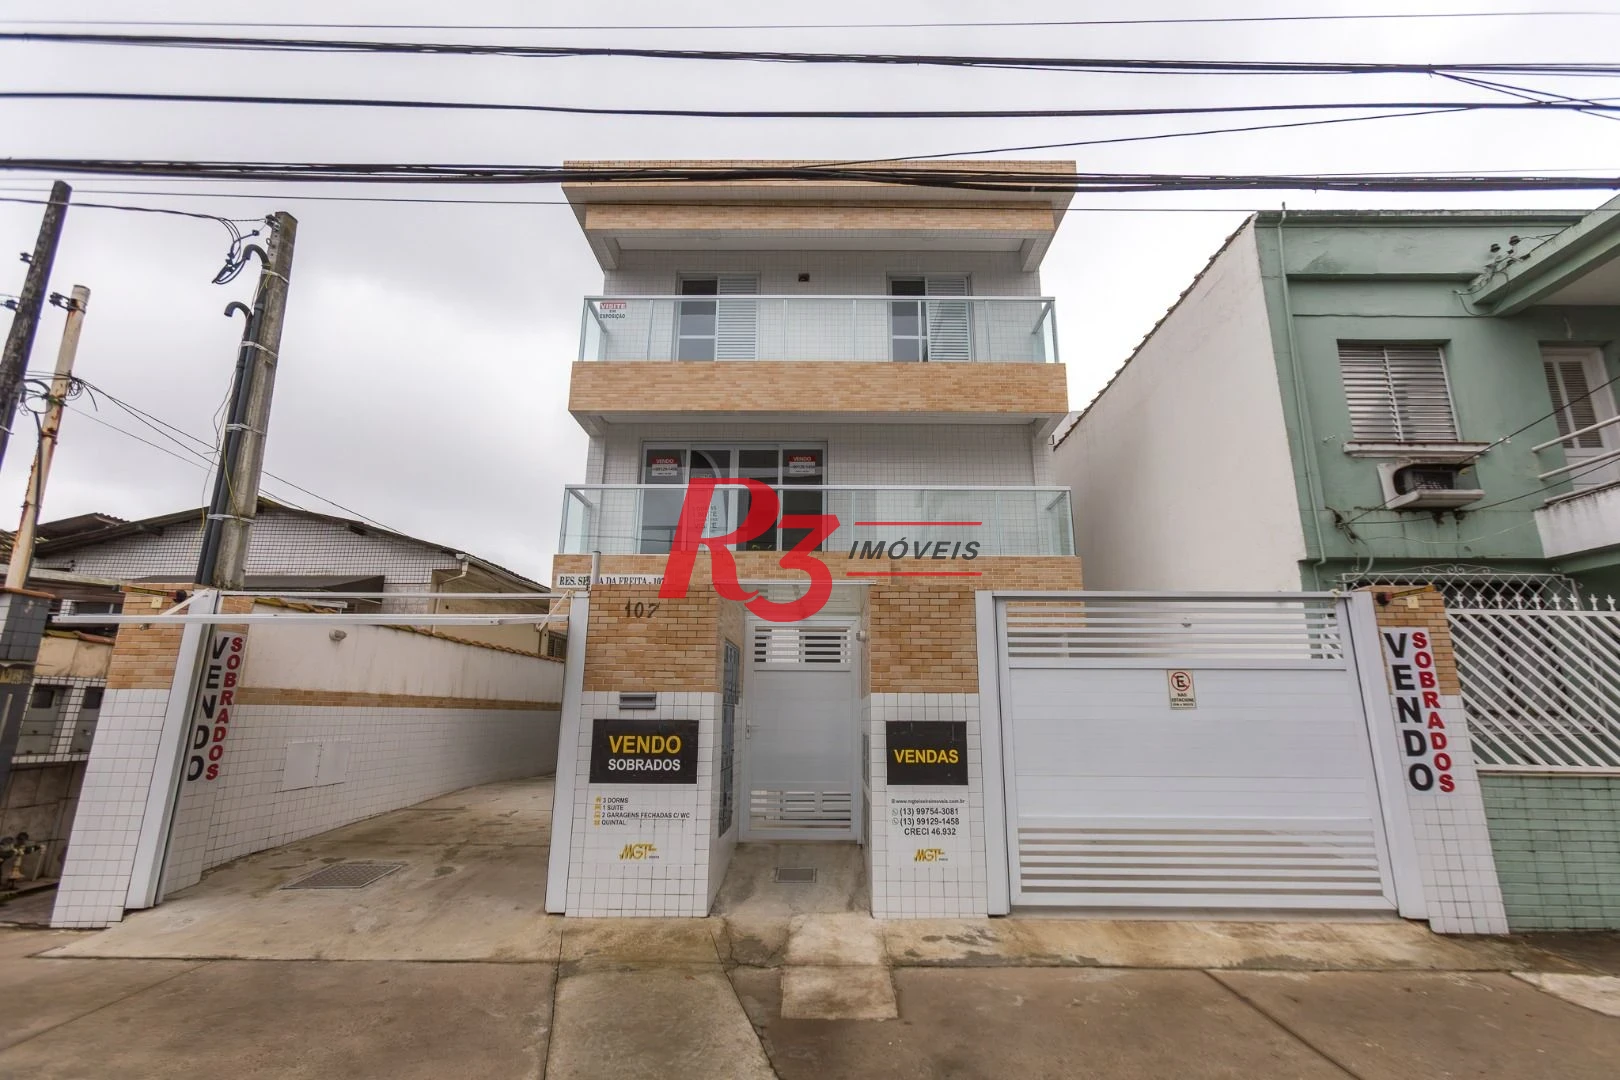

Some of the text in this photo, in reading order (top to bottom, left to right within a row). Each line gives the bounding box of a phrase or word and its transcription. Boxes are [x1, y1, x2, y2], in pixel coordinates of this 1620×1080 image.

[560, 576, 577, 586] RES.
[606, 577, 617, 585] DA
[625, 599, 660, 618] 107
[187, 636, 230, 781] VENDO
[206, 637, 243, 780] SOBRADOS
[1384, 633, 1434, 791] VENDO
[1412, 632, 1455, 792] SOBRADOS
[608, 735, 683, 754] VENDO
[607, 759, 681, 771] SOBRADOS
[894, 749, 960, 764] VENDAS
[900, 808, 959, 816] (13) 99754-3081
[900, 818, 960, 826] (13) 99129-1458
[904, 828, 957, 836] CRECI 46.932
